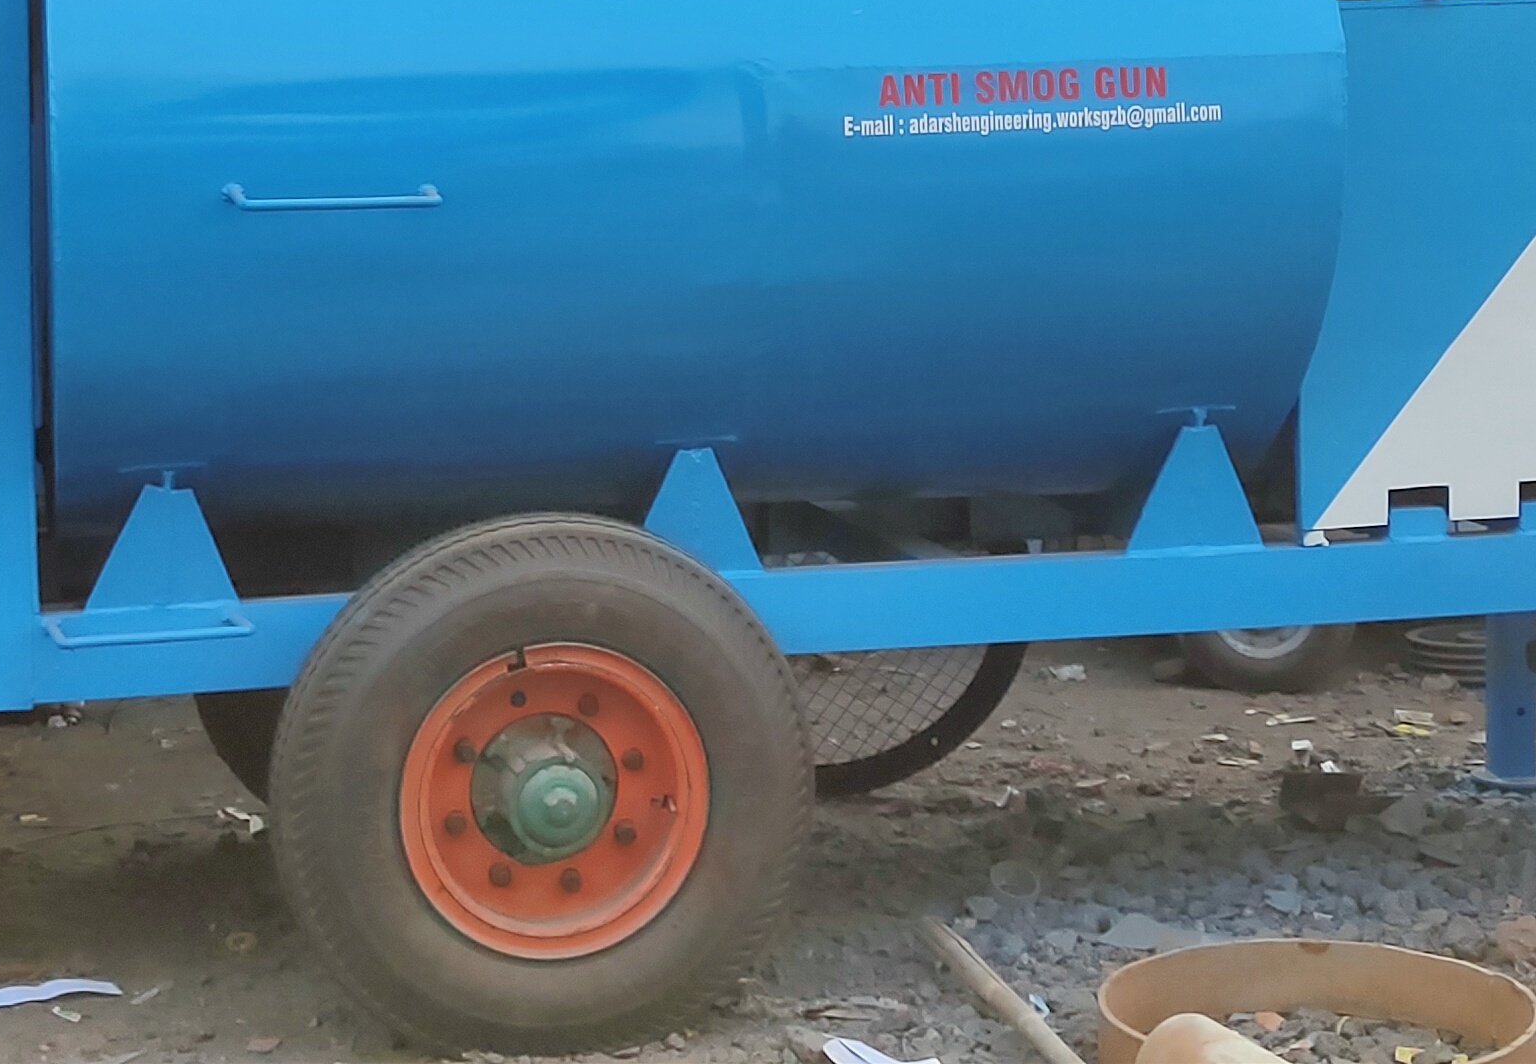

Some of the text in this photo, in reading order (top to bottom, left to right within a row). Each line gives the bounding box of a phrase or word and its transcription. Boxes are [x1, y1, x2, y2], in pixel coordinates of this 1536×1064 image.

[878, 65, 1168, 108] ANTI SMOG GUN
[843, 114, 894, 137] E-mail
[908, 101, 1223, 136] adarshengineering.worksgzb@gmail.com
